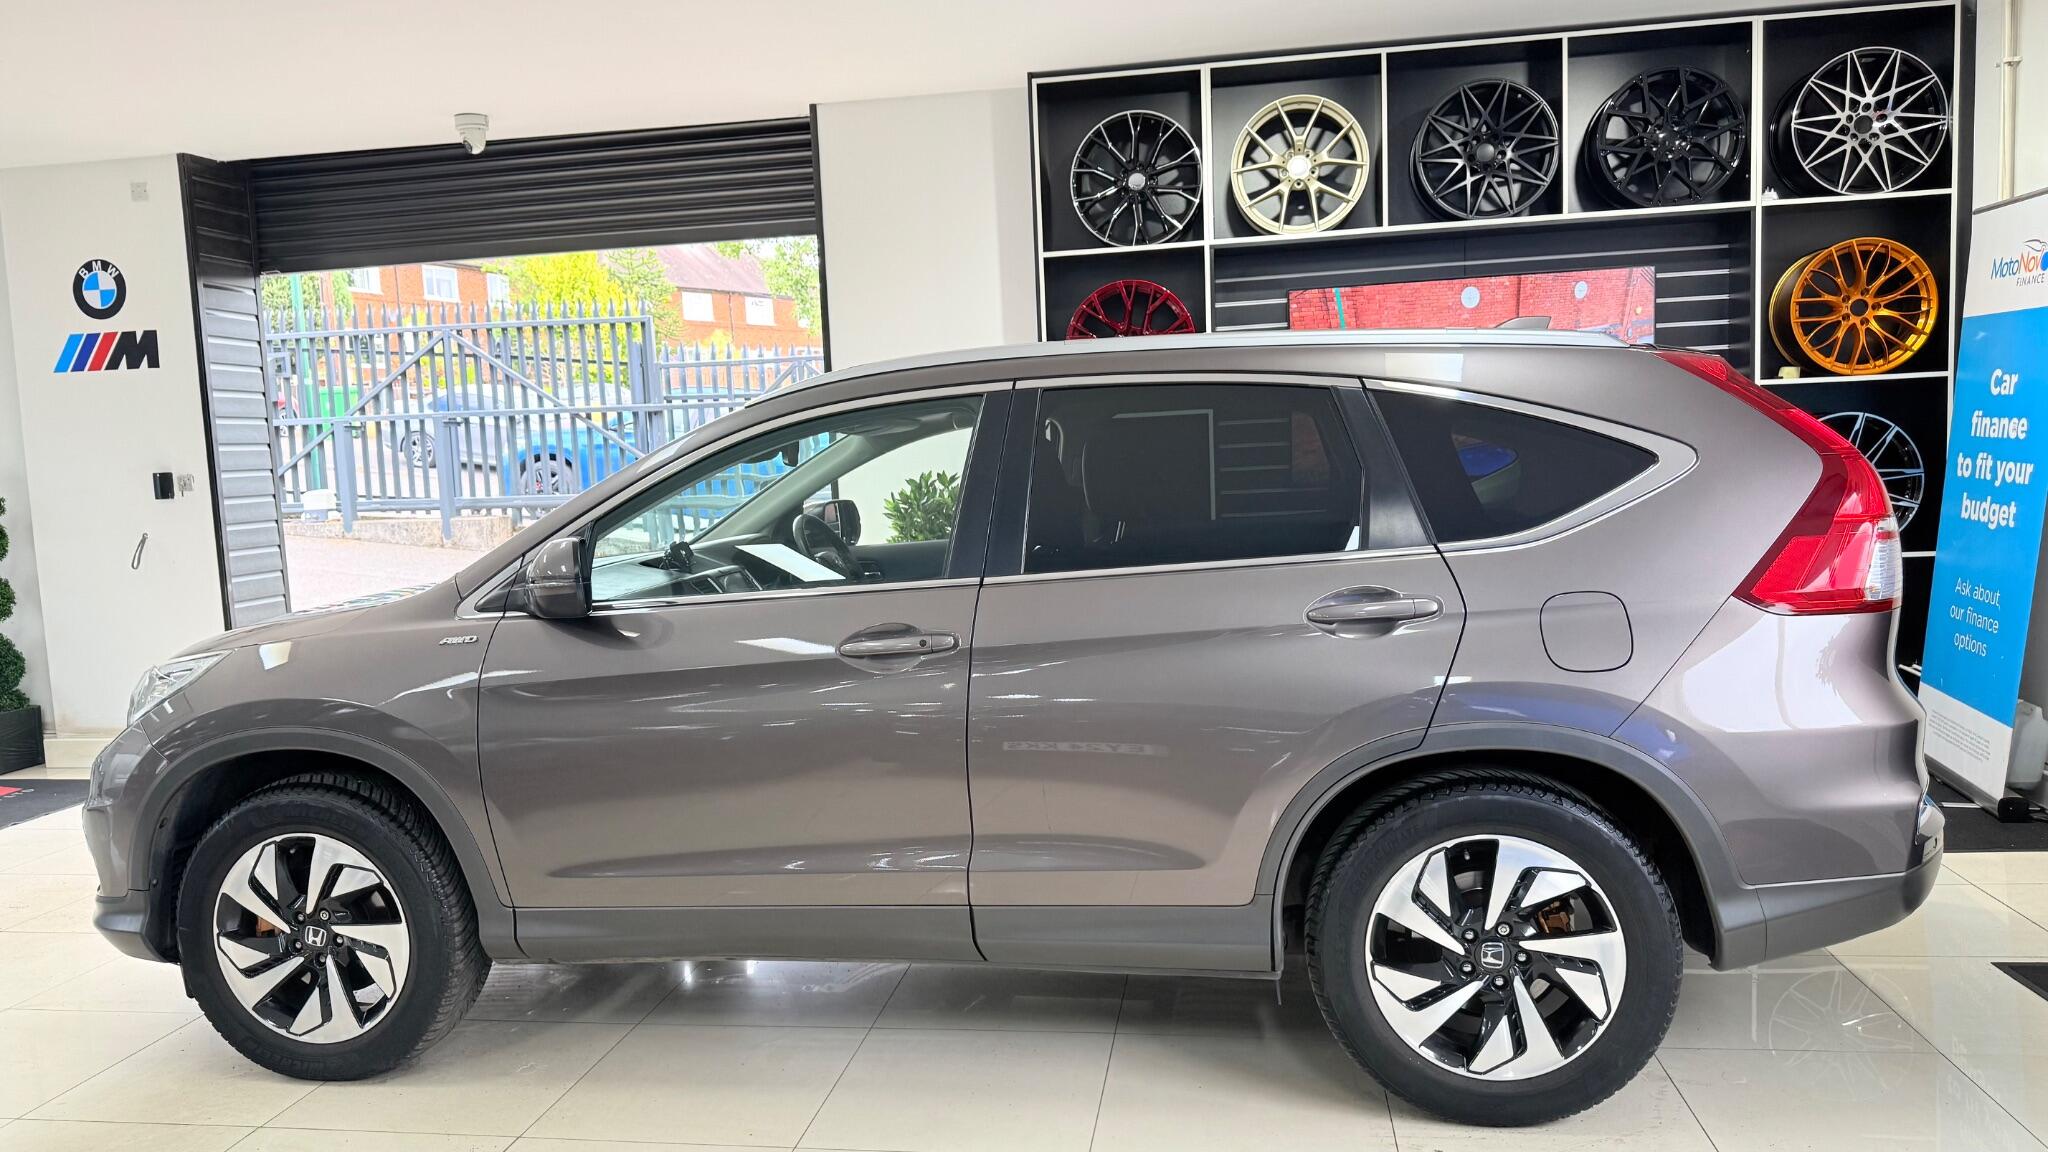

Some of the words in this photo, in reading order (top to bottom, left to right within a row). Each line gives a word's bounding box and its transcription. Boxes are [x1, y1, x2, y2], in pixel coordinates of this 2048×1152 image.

[78, 260, 120, 279] BMW
[2016, 273, 2045, 287] FINANCE
[1989, 368, 2019, 396] Car
[1970, 410, 2028, 440] finance
[1956, 452, 1972, 478] to
[1975, 452, 1993, 480] fit
[1994, 460, 2034, 487] your
[1960, 492, 2017, 530] budget
[1954, 577, 1972, 597] Ask
[1949, 605, 1964, 621] our
[1966, 606, 1999, 634] finance
[1953, 633, 1987, 657] options
